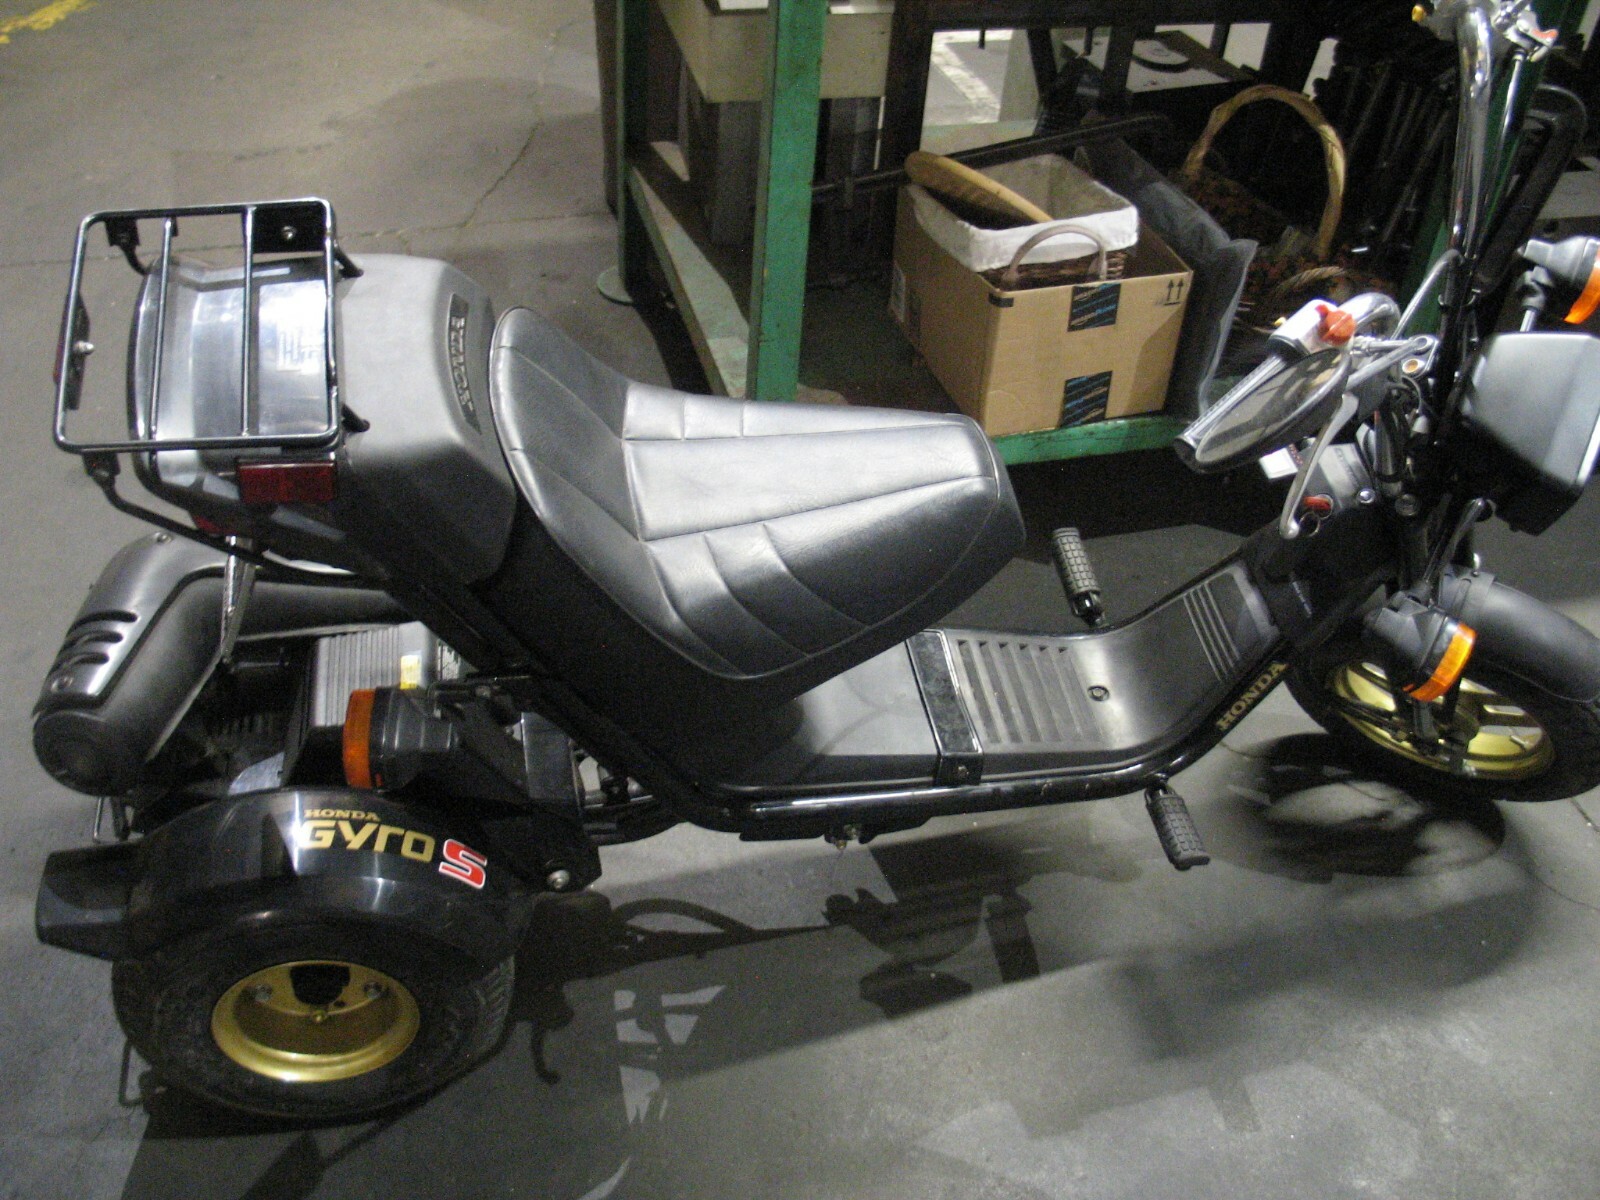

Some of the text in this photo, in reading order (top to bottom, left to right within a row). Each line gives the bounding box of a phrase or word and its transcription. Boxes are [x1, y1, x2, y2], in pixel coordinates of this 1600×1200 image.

[1216, 663, 1287, 730] HONDA
[304, 809, 380, 821] HONDA
[439, 838, 488, 890] S
